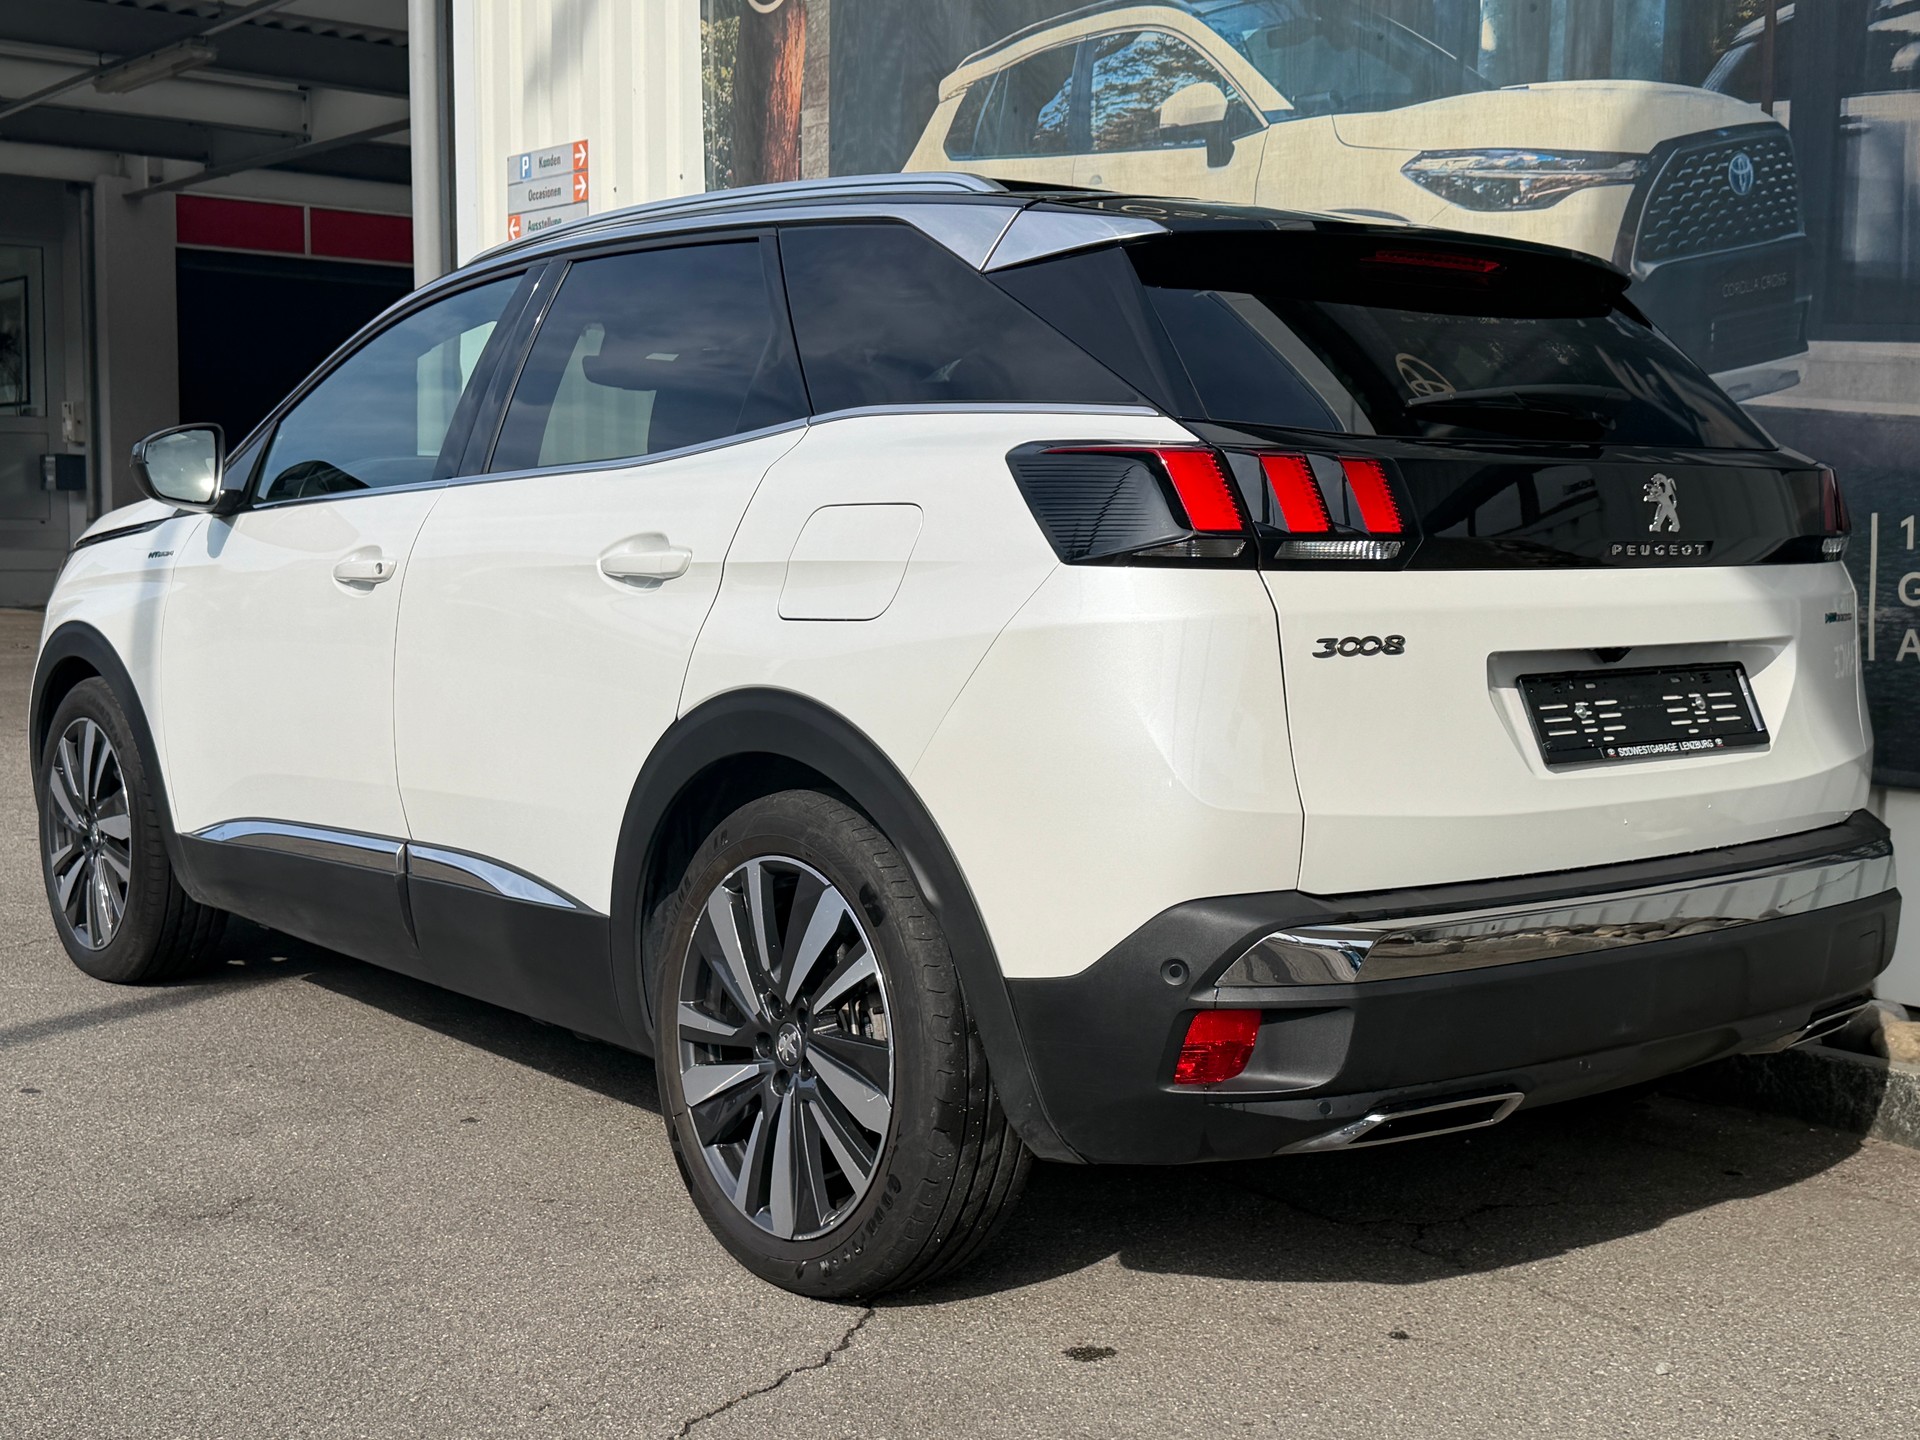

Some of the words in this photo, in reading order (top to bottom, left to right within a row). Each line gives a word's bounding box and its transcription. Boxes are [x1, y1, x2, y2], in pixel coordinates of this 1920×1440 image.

[522, 156, 529, 177] P
[538, 154, 561, 168] Kunden
[528, 186, 561, 201] Occasionen
[1611, 544, 1704, 556] PEUGEOT
[1312, 635, 1405, 658] 3008
[1679, 739, 1714, 751] LENZBURG
